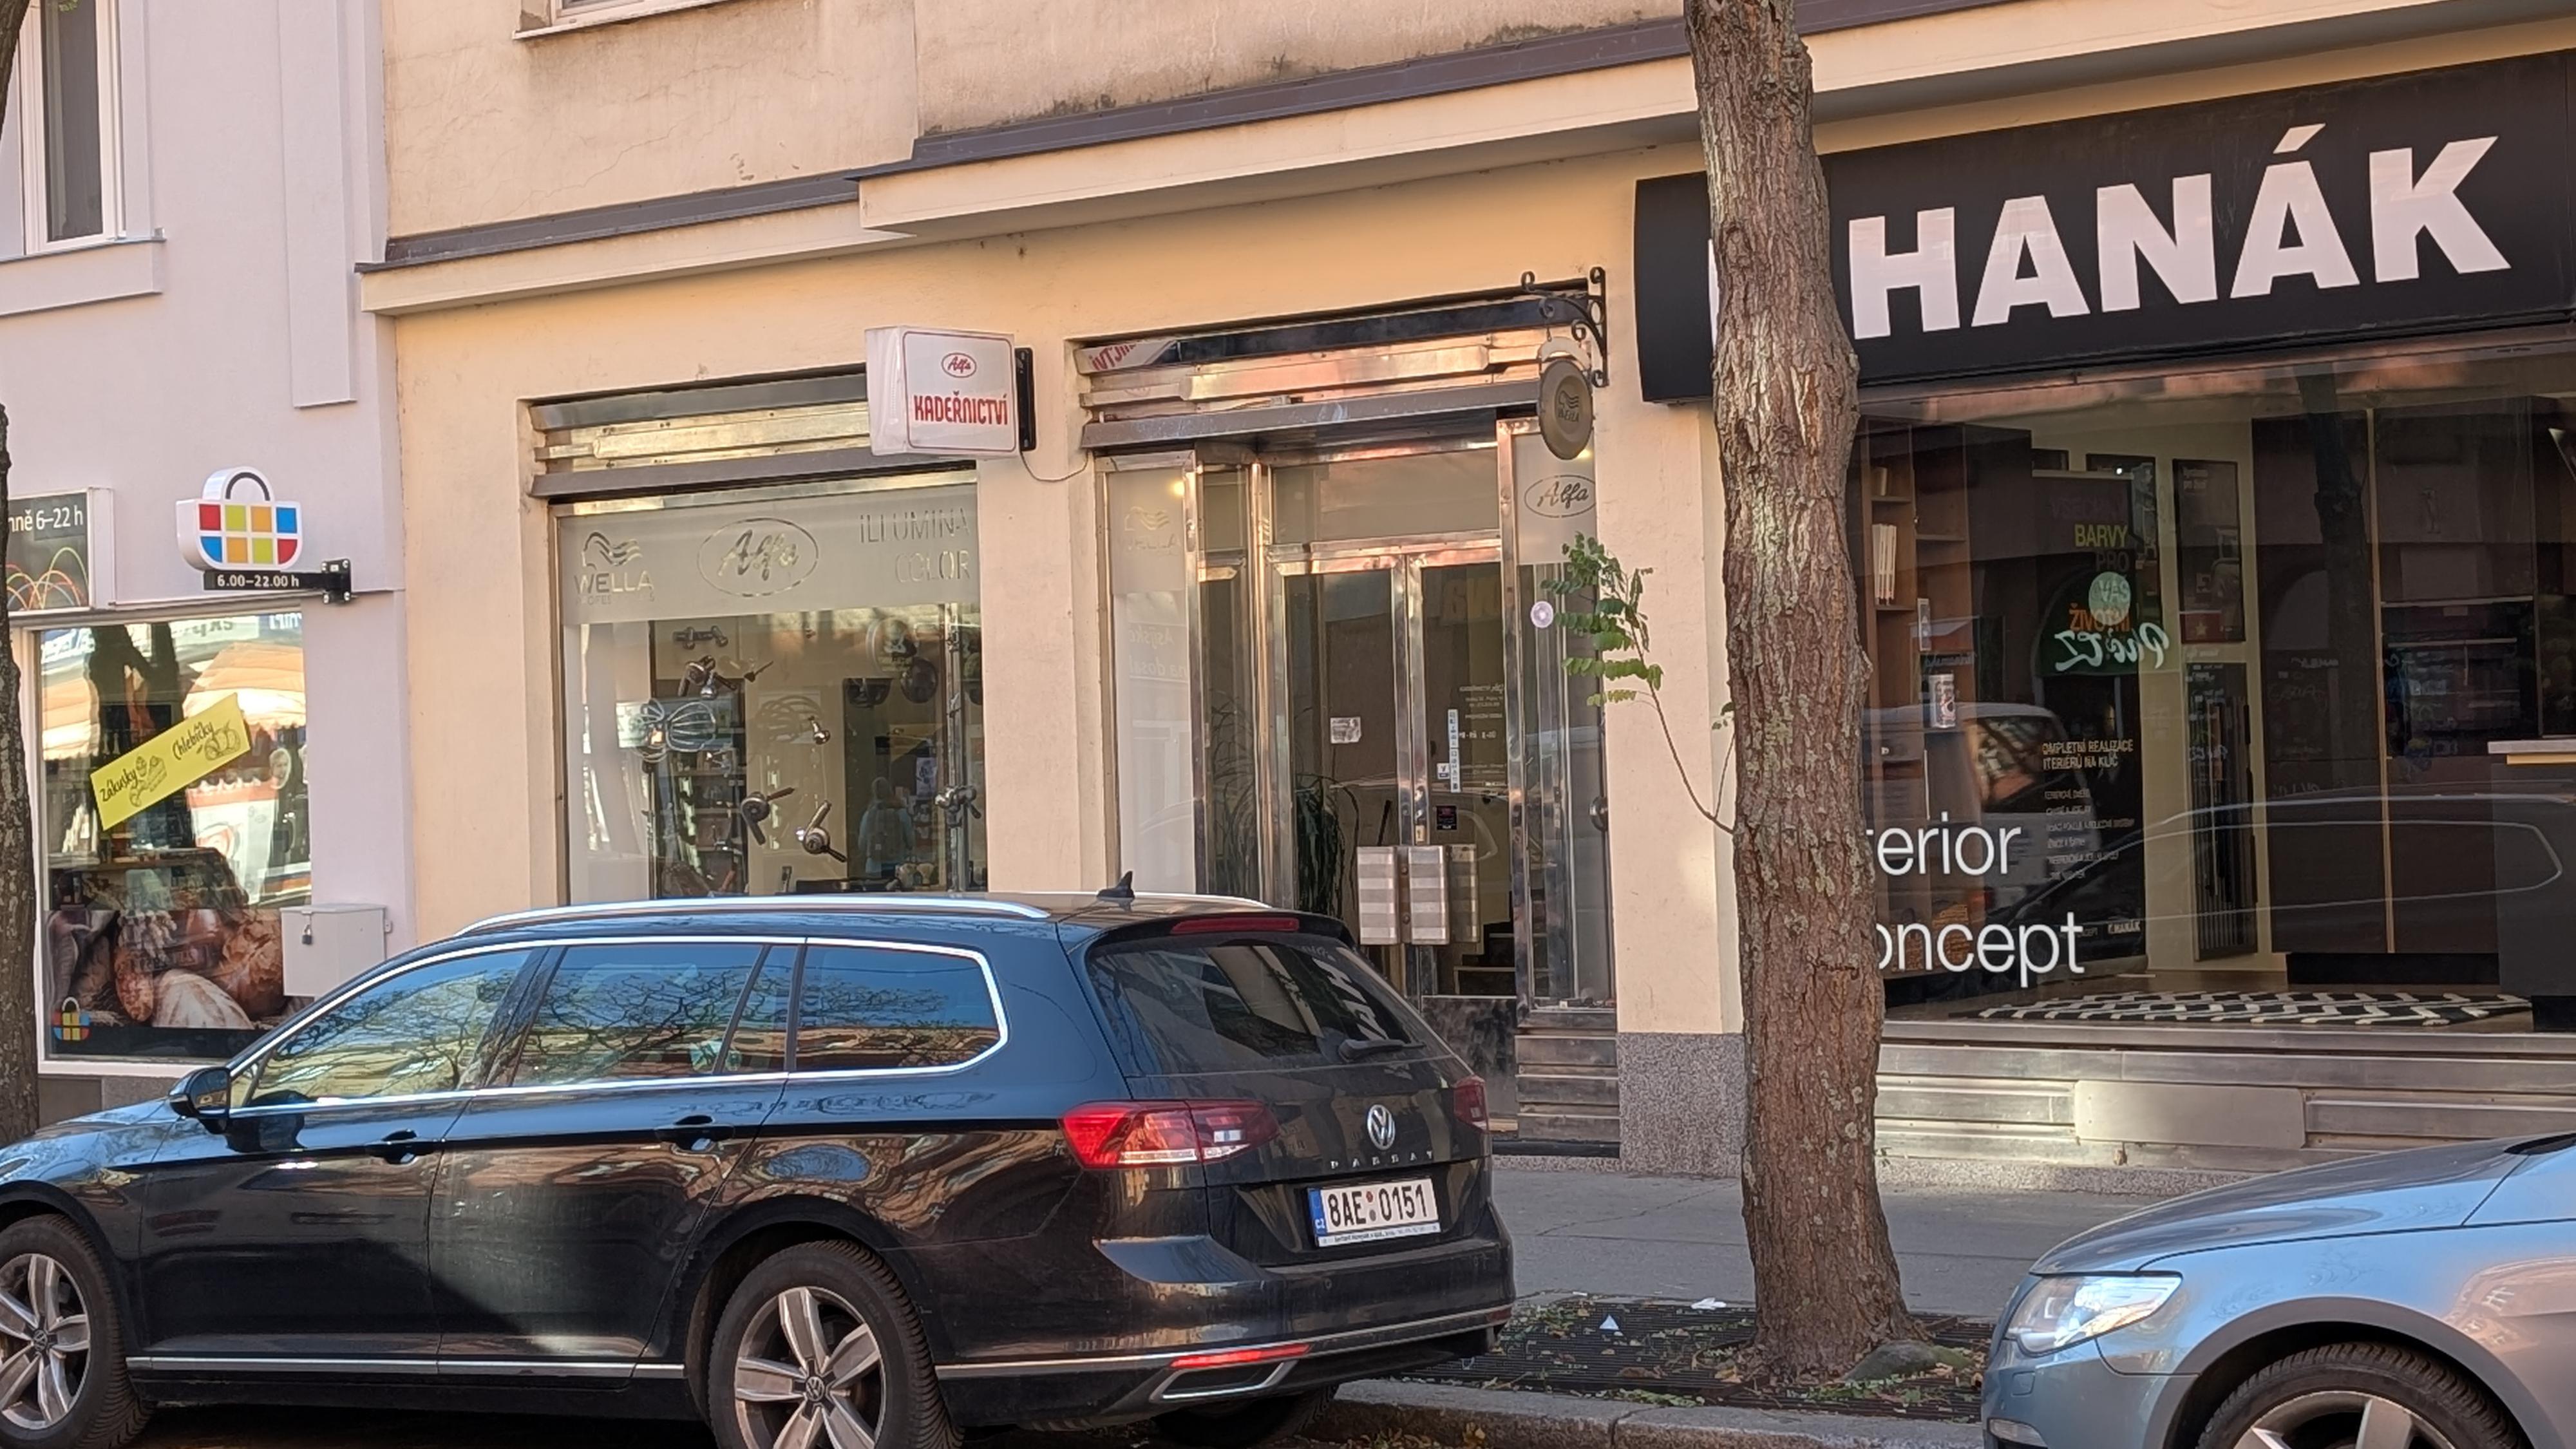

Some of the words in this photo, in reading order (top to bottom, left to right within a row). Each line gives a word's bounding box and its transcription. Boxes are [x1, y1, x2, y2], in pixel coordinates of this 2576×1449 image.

[1848, 124, 2510, 339] HANÁK
[947, 355, 971, 374] Alfa
[913, 390, 1008, 426] KADEŘNICTVÍ
[1537, 480, 1589, 509] Alfa
[74, 505, 83, 526] h
[2074, 524, 2128, 547] BARVY
[717, 529, 799, 582] Alfa
[895, 549, 971, 583] COLOR
[2096, 550, 2130, 572] PRO
[291, 574, 299, 587] h
[573, 570, 655, 594] WELLA
[1866, 811, 2022, 876] erior
[1330, 1150, 1433, 1169] PASSAT
[1327, 1190, 1367, 1227] 8AE
[1379, 1184, 1427, 1221] 0151
